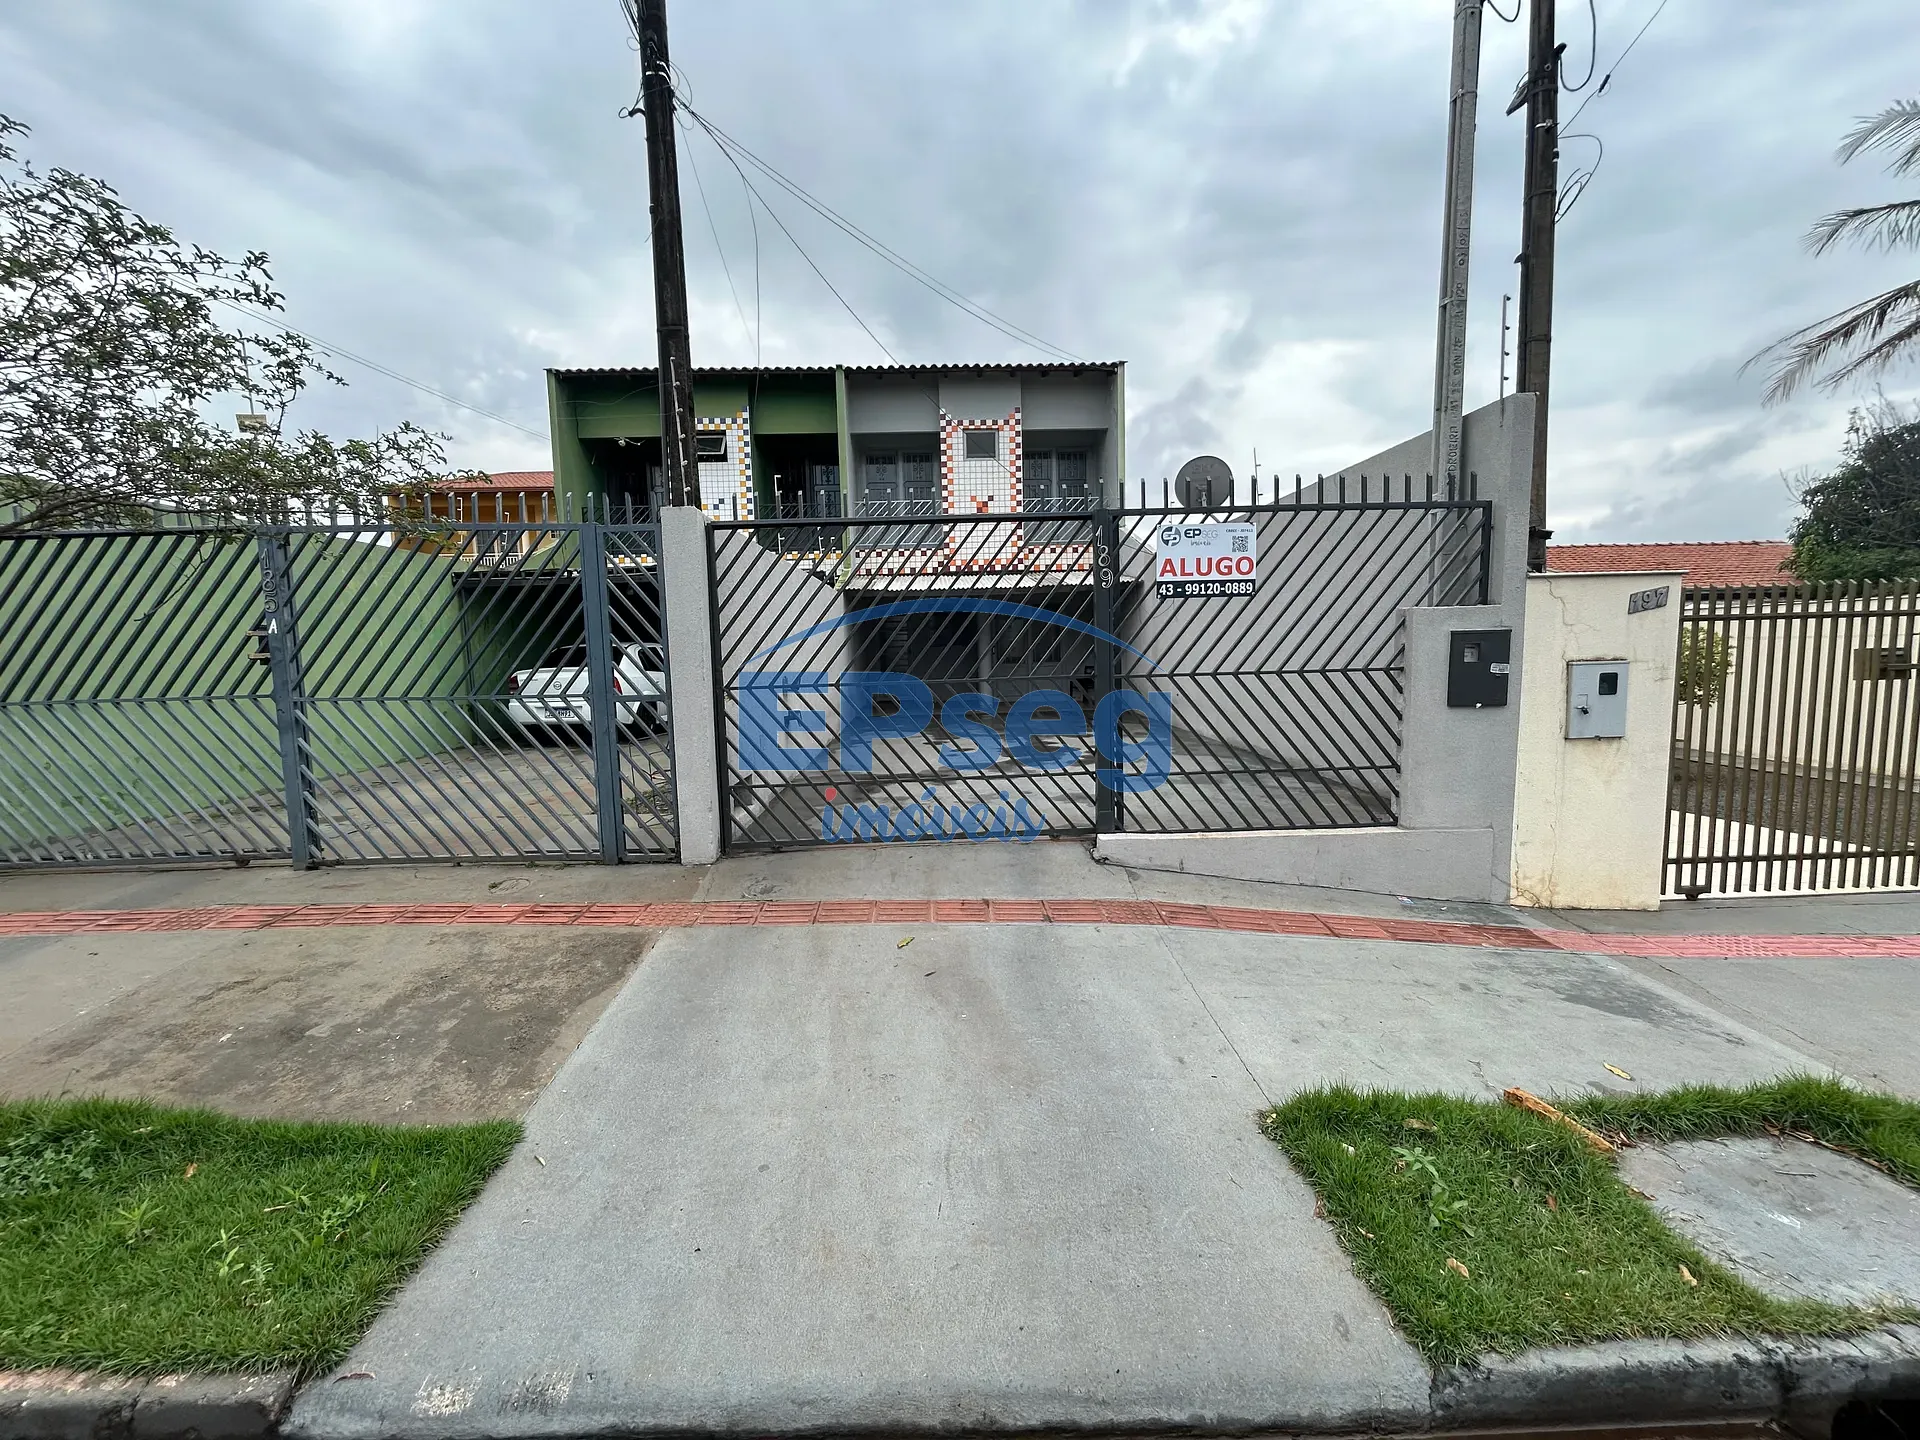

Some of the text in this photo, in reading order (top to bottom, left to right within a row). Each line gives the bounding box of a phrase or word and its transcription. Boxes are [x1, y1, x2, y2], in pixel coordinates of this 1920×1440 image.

[1095, 525, 1114, 588] 189
[1159, 556, 1255, 577] ALUGO
[1159, 584, 1174, 595] 43
[1185, 582, 1253, 595] 99120-0889
[1632, 588, 1668, 611] 197
